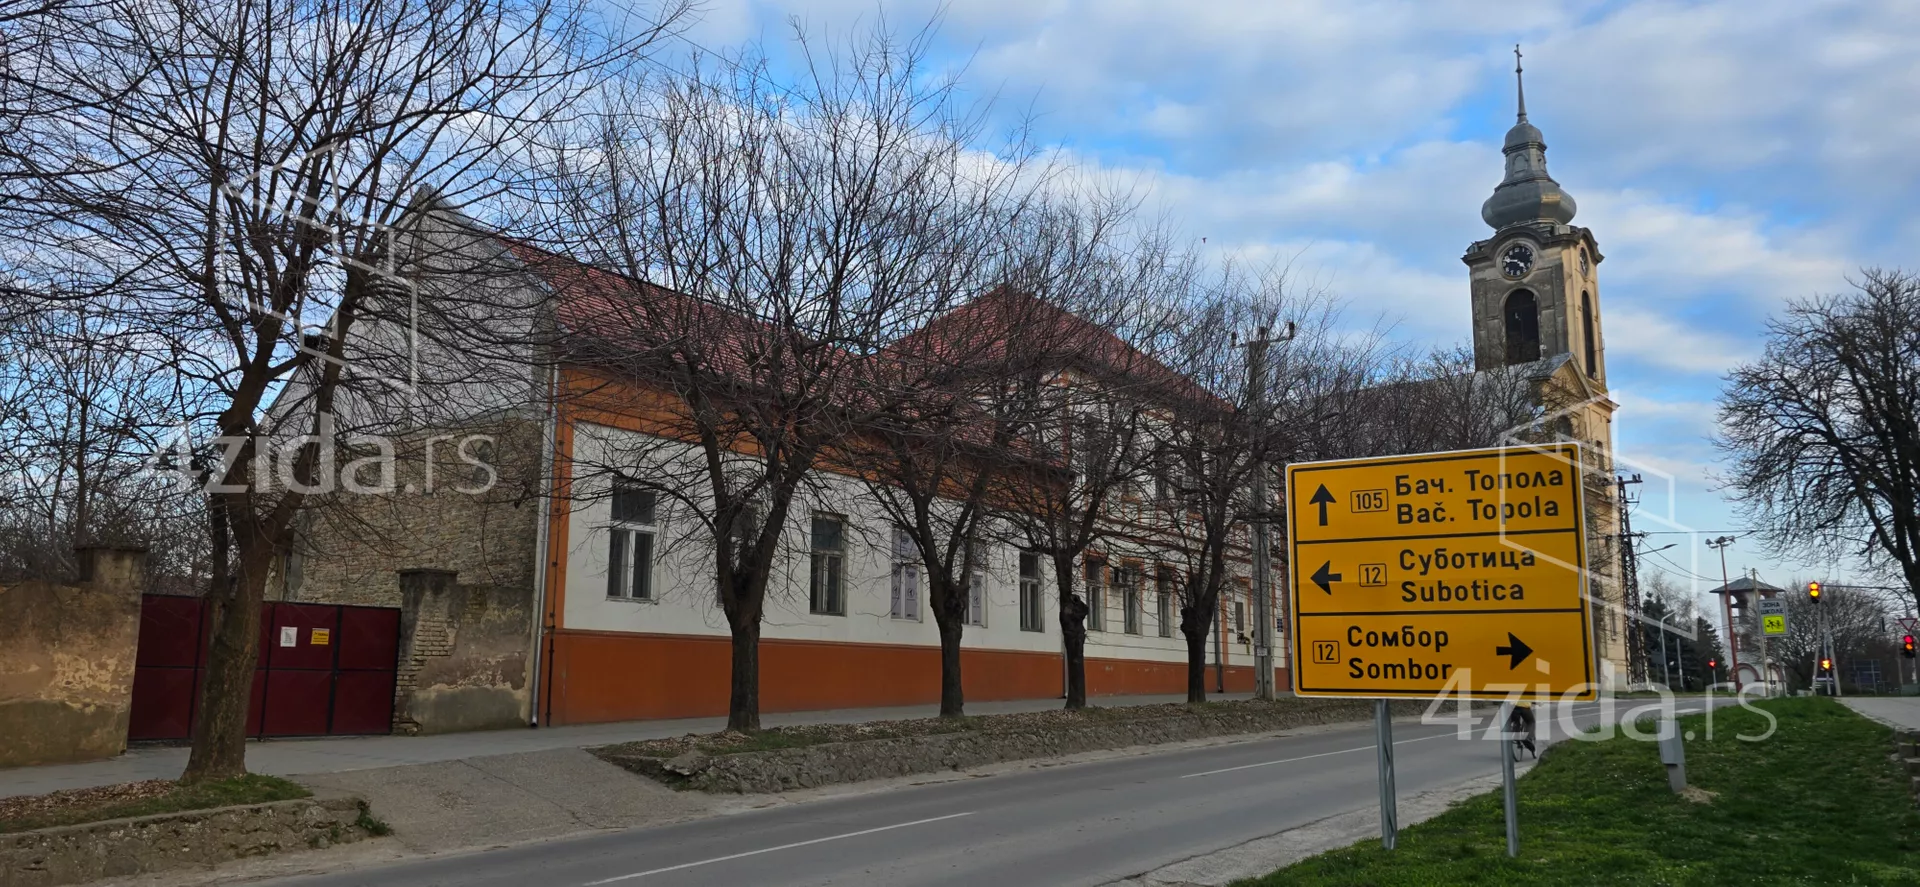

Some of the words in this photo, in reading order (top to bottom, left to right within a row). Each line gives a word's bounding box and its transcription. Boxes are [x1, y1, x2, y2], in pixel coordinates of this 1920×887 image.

[1395, 474, 1453, 496] Бач.
[1464, 469, 1563, 491] Топола
[1356, 492, 1383, 510] 105
[1397, 501, 1455, 524] Bač.
[1467, 496, 1559, 525] Topola
[1400, 548, 1536, 576] Суботица
[1364, 567, 1382, 584] 12
[1401, 580, 1525, 602] Subotica
[1347, 625, 1449, 652] Сомбор
[1318, 644, 1334, 661] 12
[1348, 657, 1452, 680] Sombor
